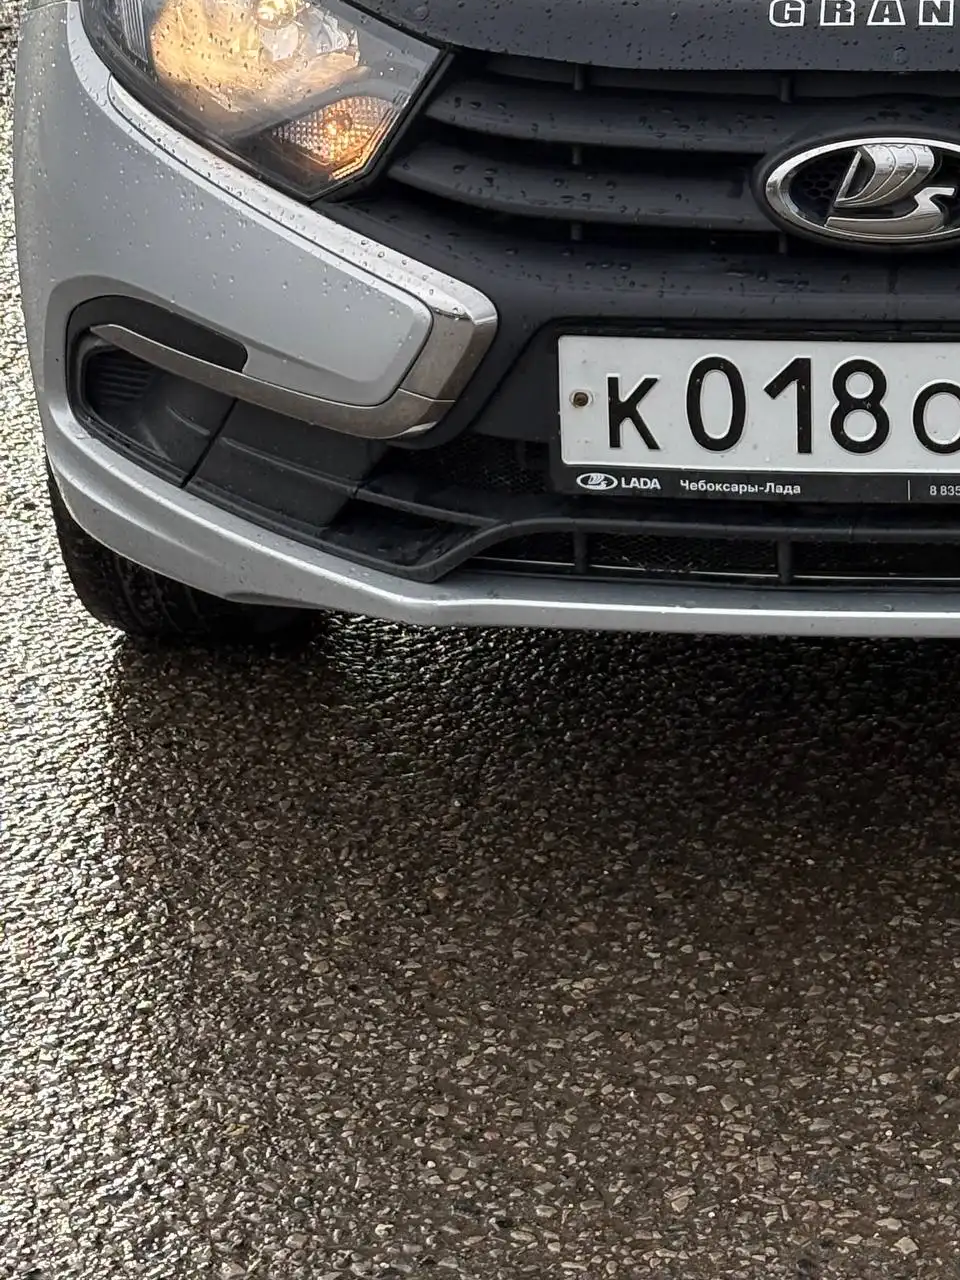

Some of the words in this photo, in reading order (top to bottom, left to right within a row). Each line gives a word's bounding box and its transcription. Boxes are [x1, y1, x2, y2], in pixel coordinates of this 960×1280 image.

[620, 476, 662, 490] LADA
[679, 478, 802, 495] Чебоксары-Лада
[929, 484, 937, 496] 8
